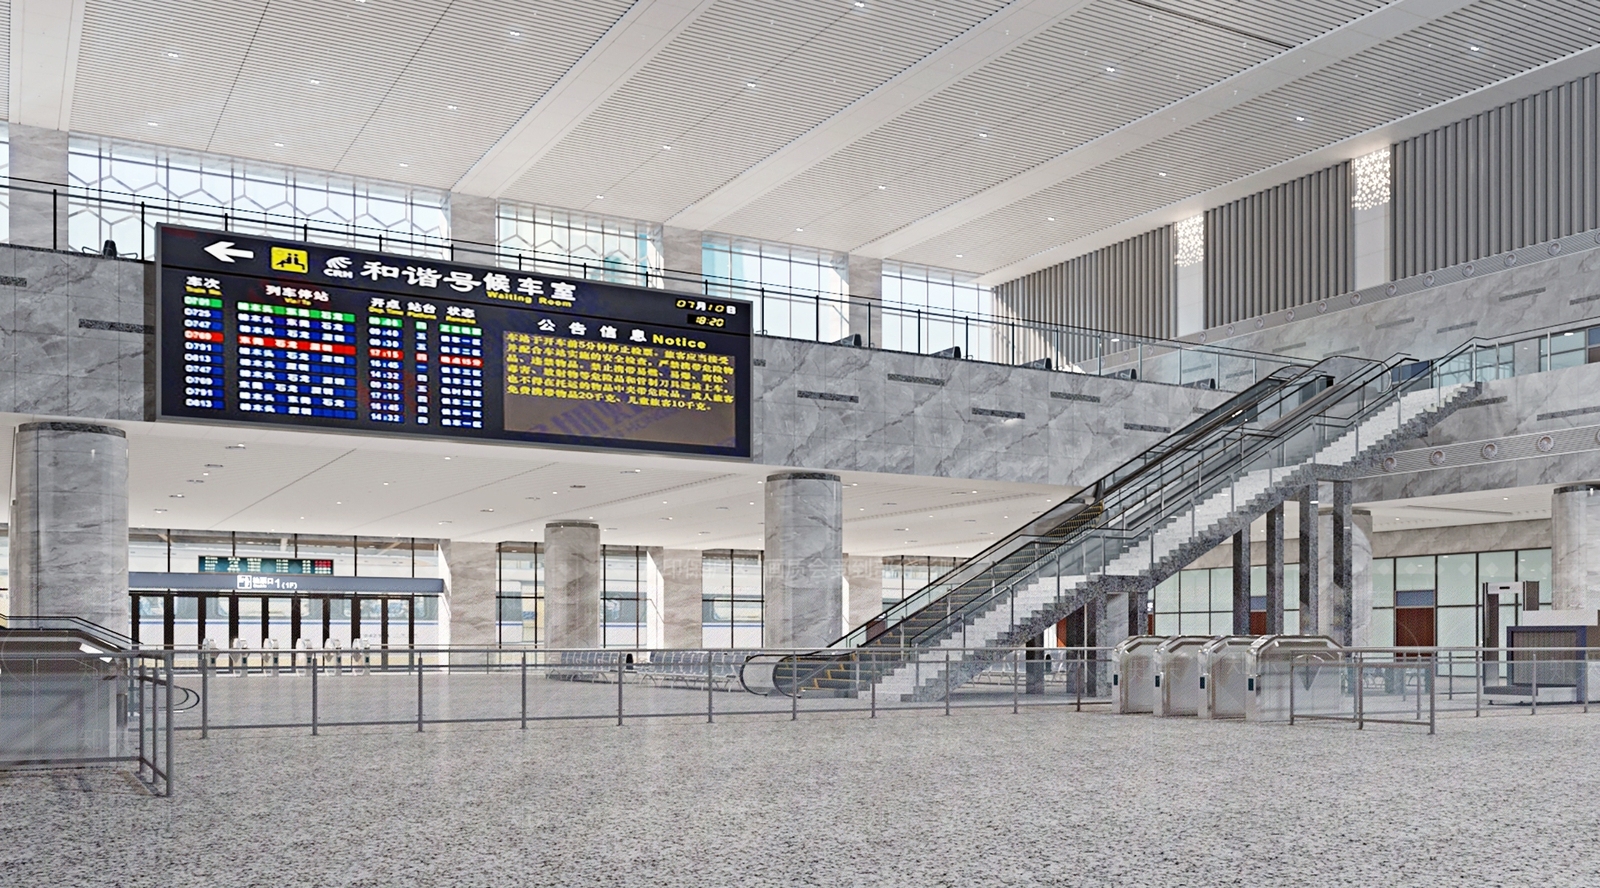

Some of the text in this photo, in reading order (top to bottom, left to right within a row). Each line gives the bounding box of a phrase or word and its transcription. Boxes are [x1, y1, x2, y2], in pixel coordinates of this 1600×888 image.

[186, 275, 221, 290] 车次
[361, 260, 577, 302] 和谐号候车室
[265, 285, 330, 302] 列车停站
[487, 290, 572, 308] Waiting Room
[370, 297, 401, 310] 开点
[406, 301, 437, 314] 站台
[446, 305, 476, 319] 状态
[695, 316, 725, 328] 18:20
[537, 318, 707, 350] 公告信息 Notice
[369, 349, 399, 359] 17:15
[370, 370, 400, 380] 14:32
[370, 391, 400, 402] 17:15
[370, 413, 400, 423] 14:32
[274, 578, 281, 589] 1
[281, 581, 298, 590] (1F)
